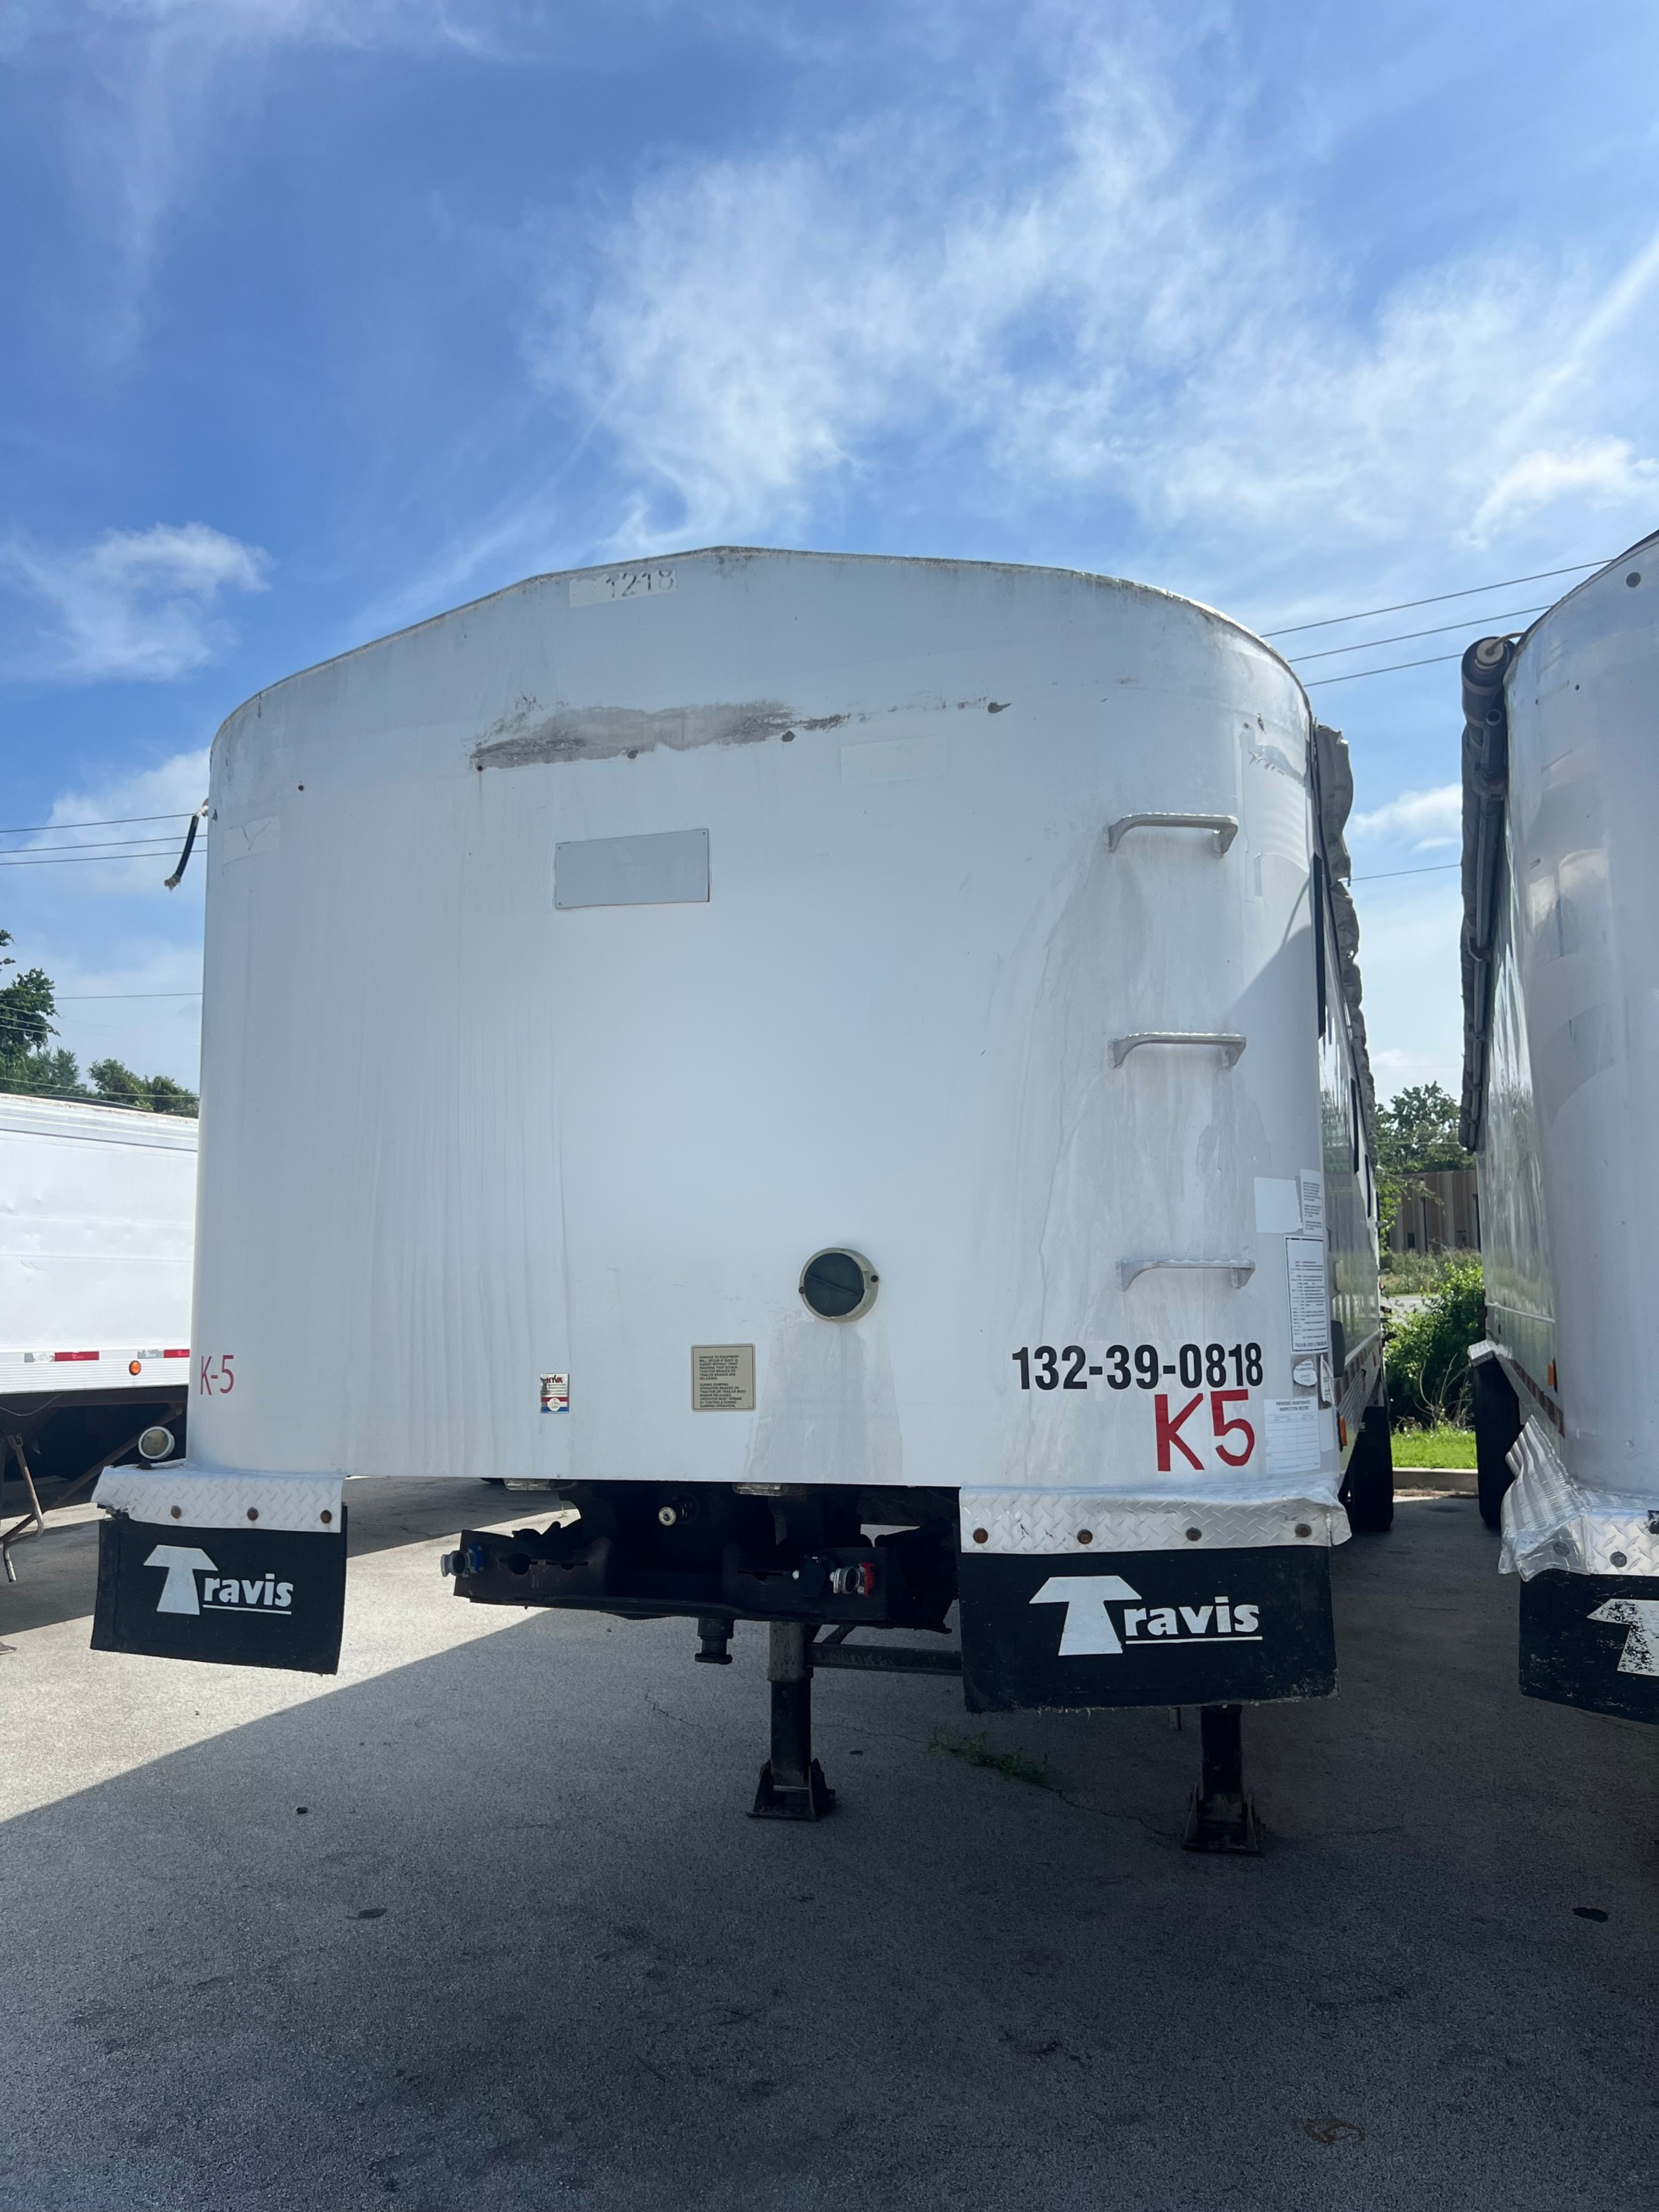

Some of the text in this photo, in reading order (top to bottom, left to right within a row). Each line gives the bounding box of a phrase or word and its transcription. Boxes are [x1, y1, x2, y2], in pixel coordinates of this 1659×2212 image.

[200, 1355, 234, 1395] K-5
[1012, 1342, 1263, 1391] 132-39-0818
[1154, 1389, 1255, 1472] K5
[143, 1544, 294, 1615] Travis
[1029, 1575, 1260, 1656] Travis
